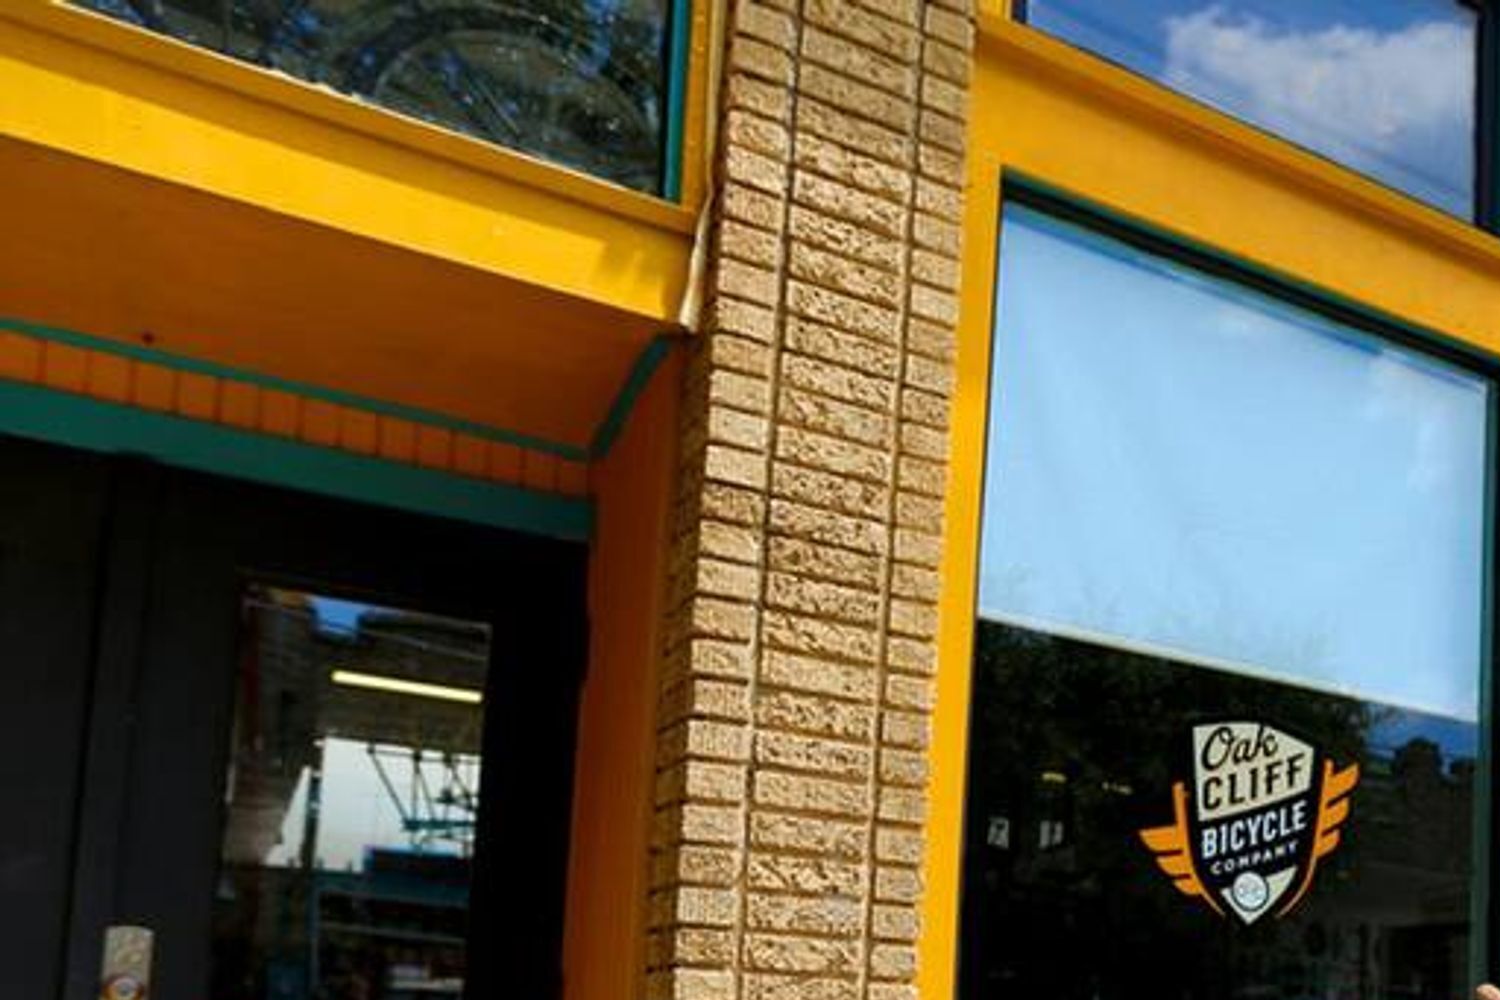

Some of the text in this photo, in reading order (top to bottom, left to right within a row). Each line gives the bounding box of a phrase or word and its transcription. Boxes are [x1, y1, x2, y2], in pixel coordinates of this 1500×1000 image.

[1202, 725, 1279, 771] Oak
[1203, 753, 1305, 811] CLIFF
[1202, 800, 1308, 860] BICYCLE
[1210, 840, 1298, 875] COMPANY
